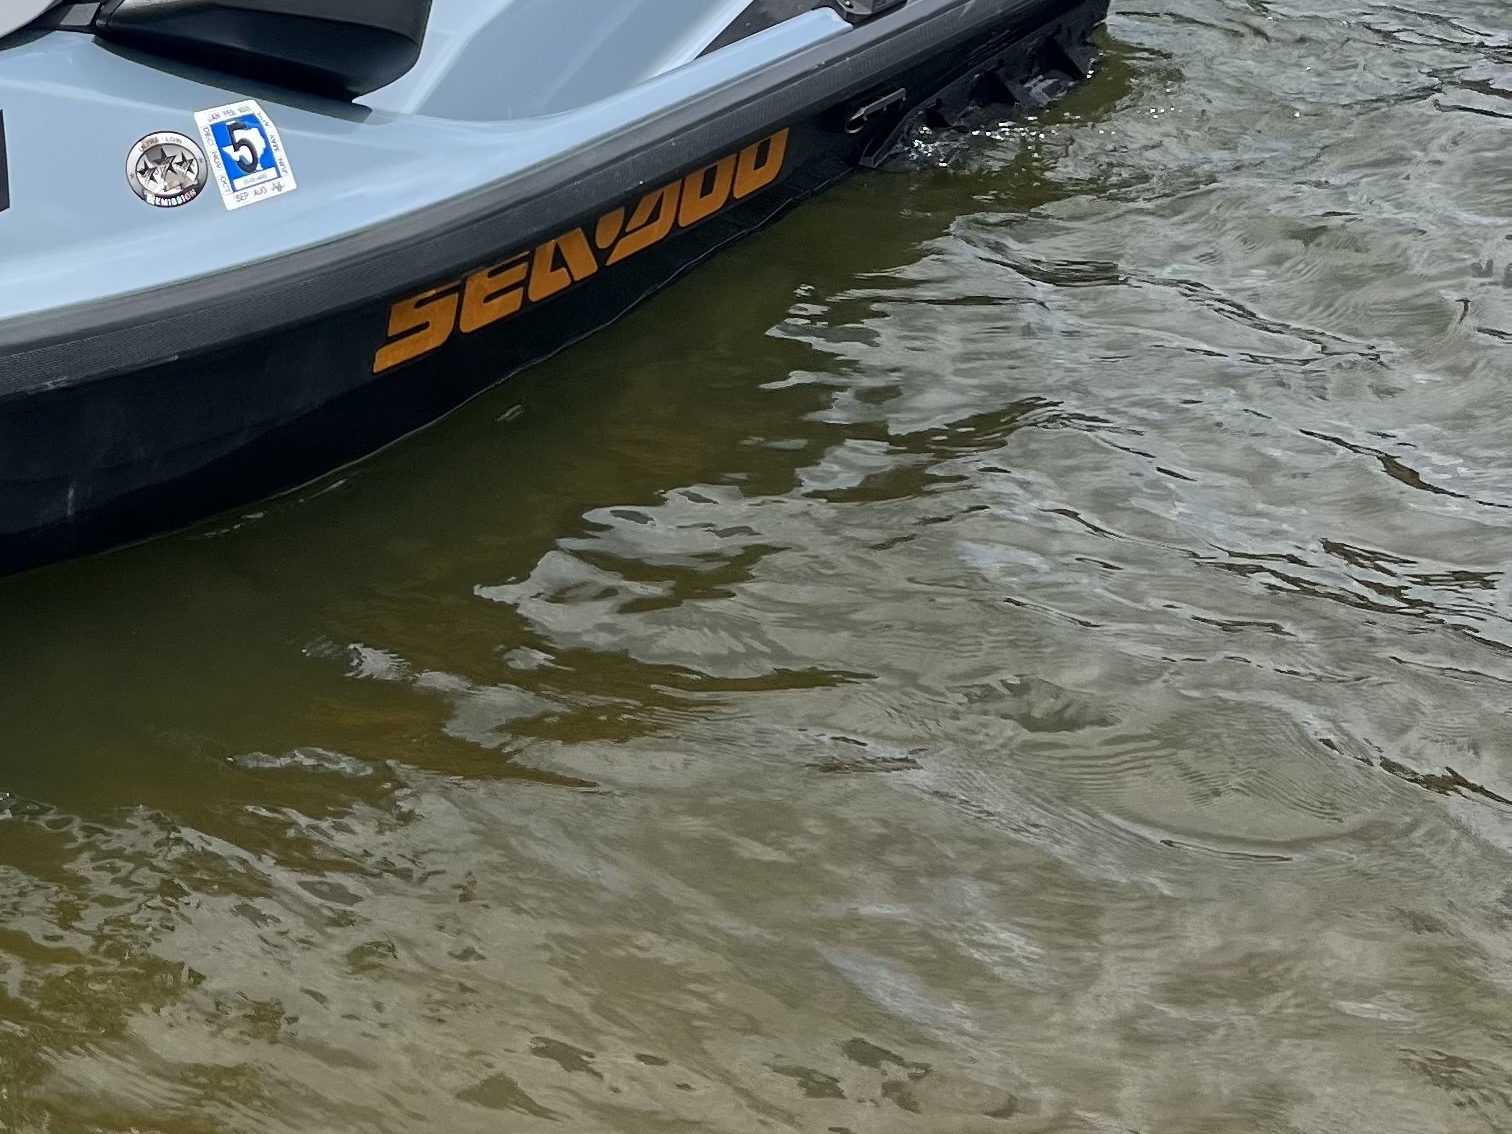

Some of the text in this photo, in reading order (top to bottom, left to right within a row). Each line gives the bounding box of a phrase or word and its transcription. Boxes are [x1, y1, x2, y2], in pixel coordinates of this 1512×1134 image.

[208, 112, 221, 122] JAN
[227, 121, 259, 174] 5
[211, 150, 222, 169] NOV
[220, 175, 233, 194] OCT
[235, 191, 249, 202] SEP
